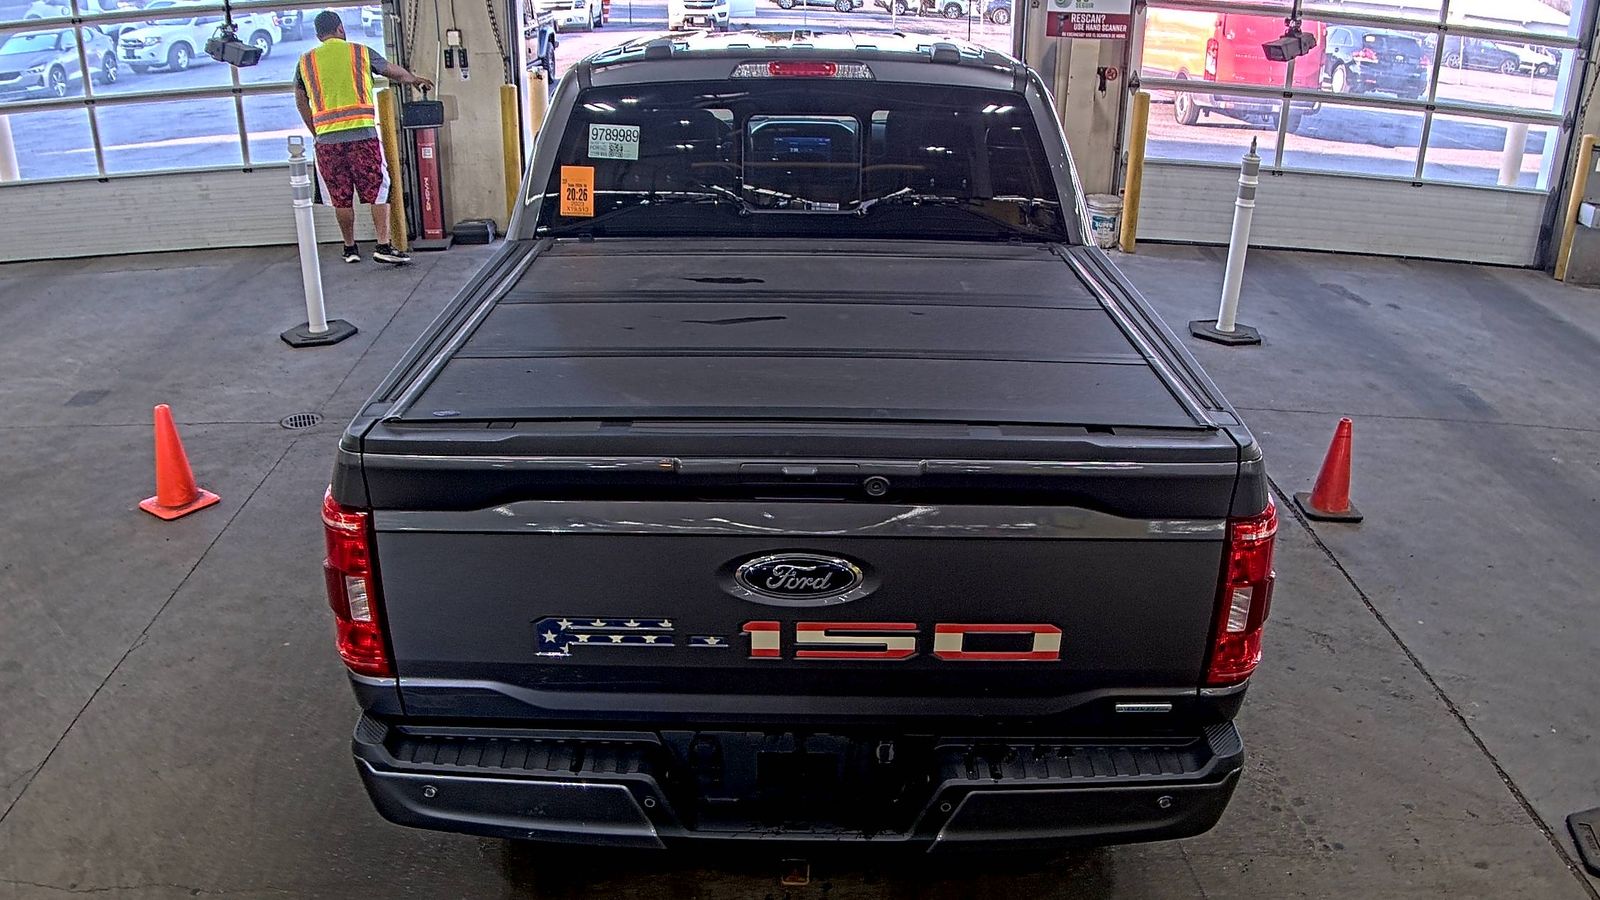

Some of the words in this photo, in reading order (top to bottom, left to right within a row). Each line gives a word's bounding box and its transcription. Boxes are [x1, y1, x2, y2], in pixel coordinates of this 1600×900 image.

[1071, 13, 1106, 24] RESCAN?
[1073, 23, 1085, 31] USE
[1085, 24, 1101, 32] HAND
[1102, 24, 1127, 32] SCANNER
[591, 127, 639, 142] 9789989
[566, 187, 588, 201] 20:26
[766, 564, 833, 590] Ford
[533, 615, 1064, 662] F-150
